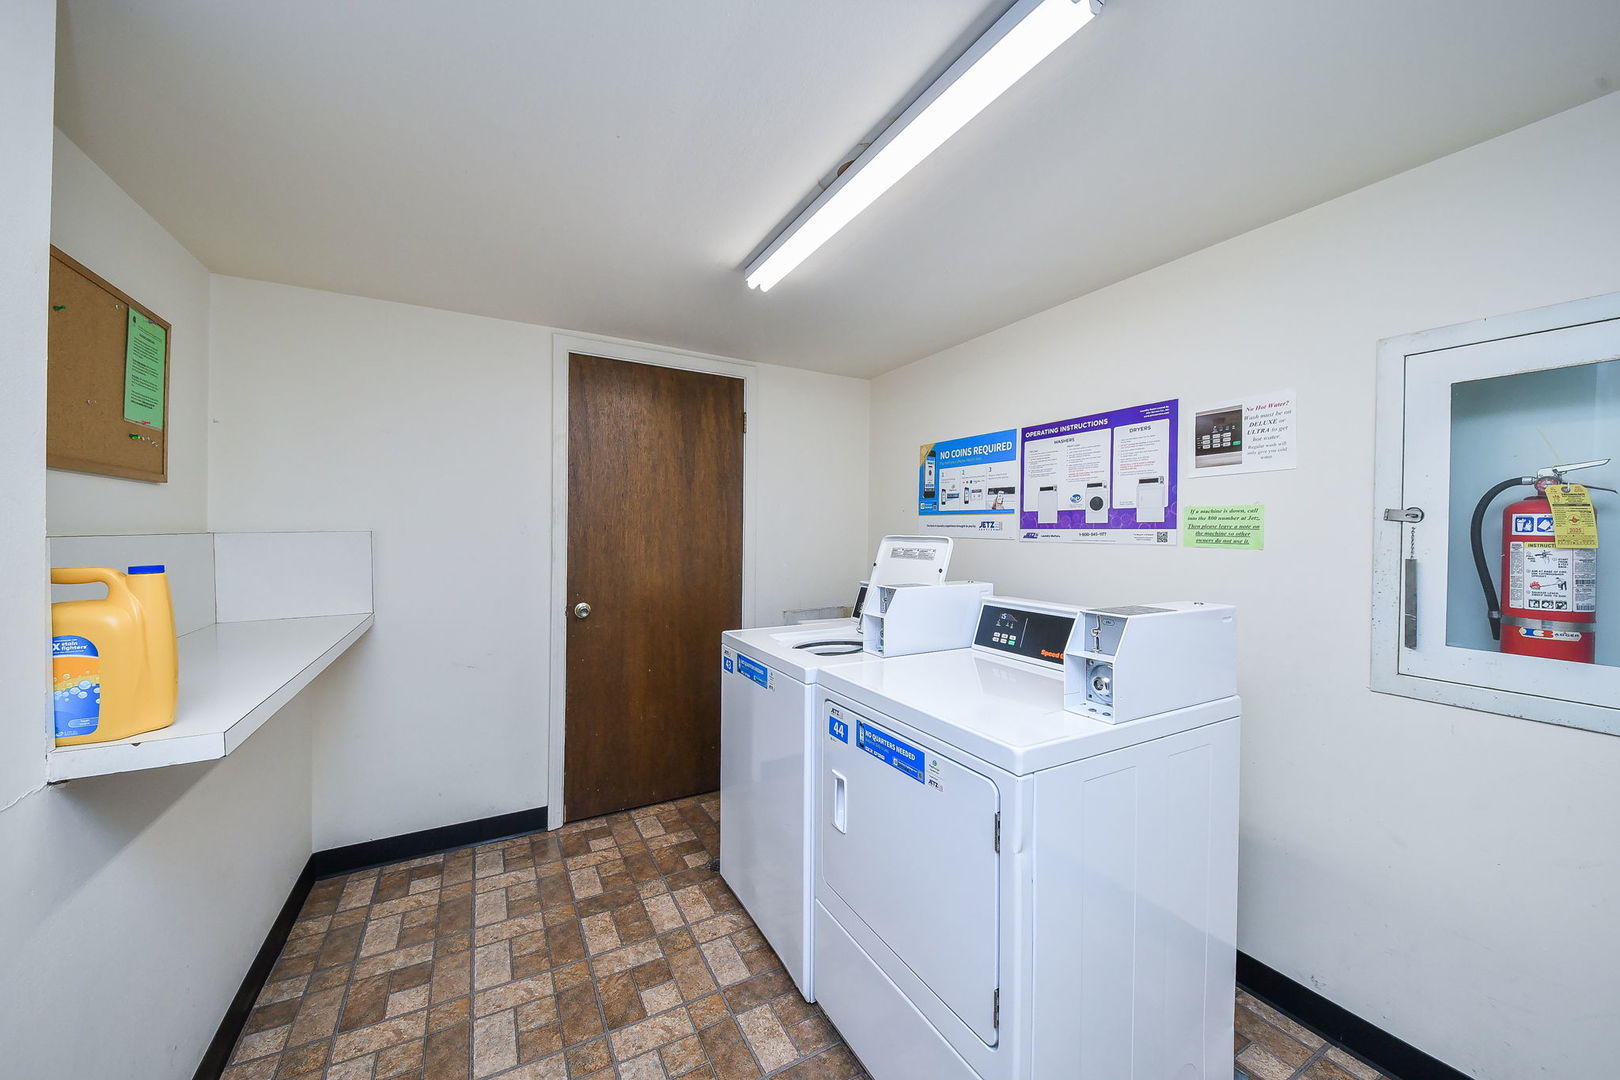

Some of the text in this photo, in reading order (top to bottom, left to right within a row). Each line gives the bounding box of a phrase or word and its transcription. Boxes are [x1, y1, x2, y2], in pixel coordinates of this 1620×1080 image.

[1268, 400, 1289, 409] Water?
[1249, 419, 1276, 427] DELUXE
[1025, 418, 1108, 438] OPERATING INSTRUCTIONS
[1129, 425, 1151, 433] DRYERS
[1247, 427, 1270, 435] ULTRA
[940, 441, 1012, 460] NO COINS REQUIRED
[979, 521, 995, 529] JETZ
[1040, 649, 1060, 659] Speed
[725, 659, 732, 670] 43
[831, 707, 840, 716] JETZ
[833, 721, 845, 738] 44
[872, 732, 896, 751] QUARTERS
[896, 745, 916, 761] NEEDED
